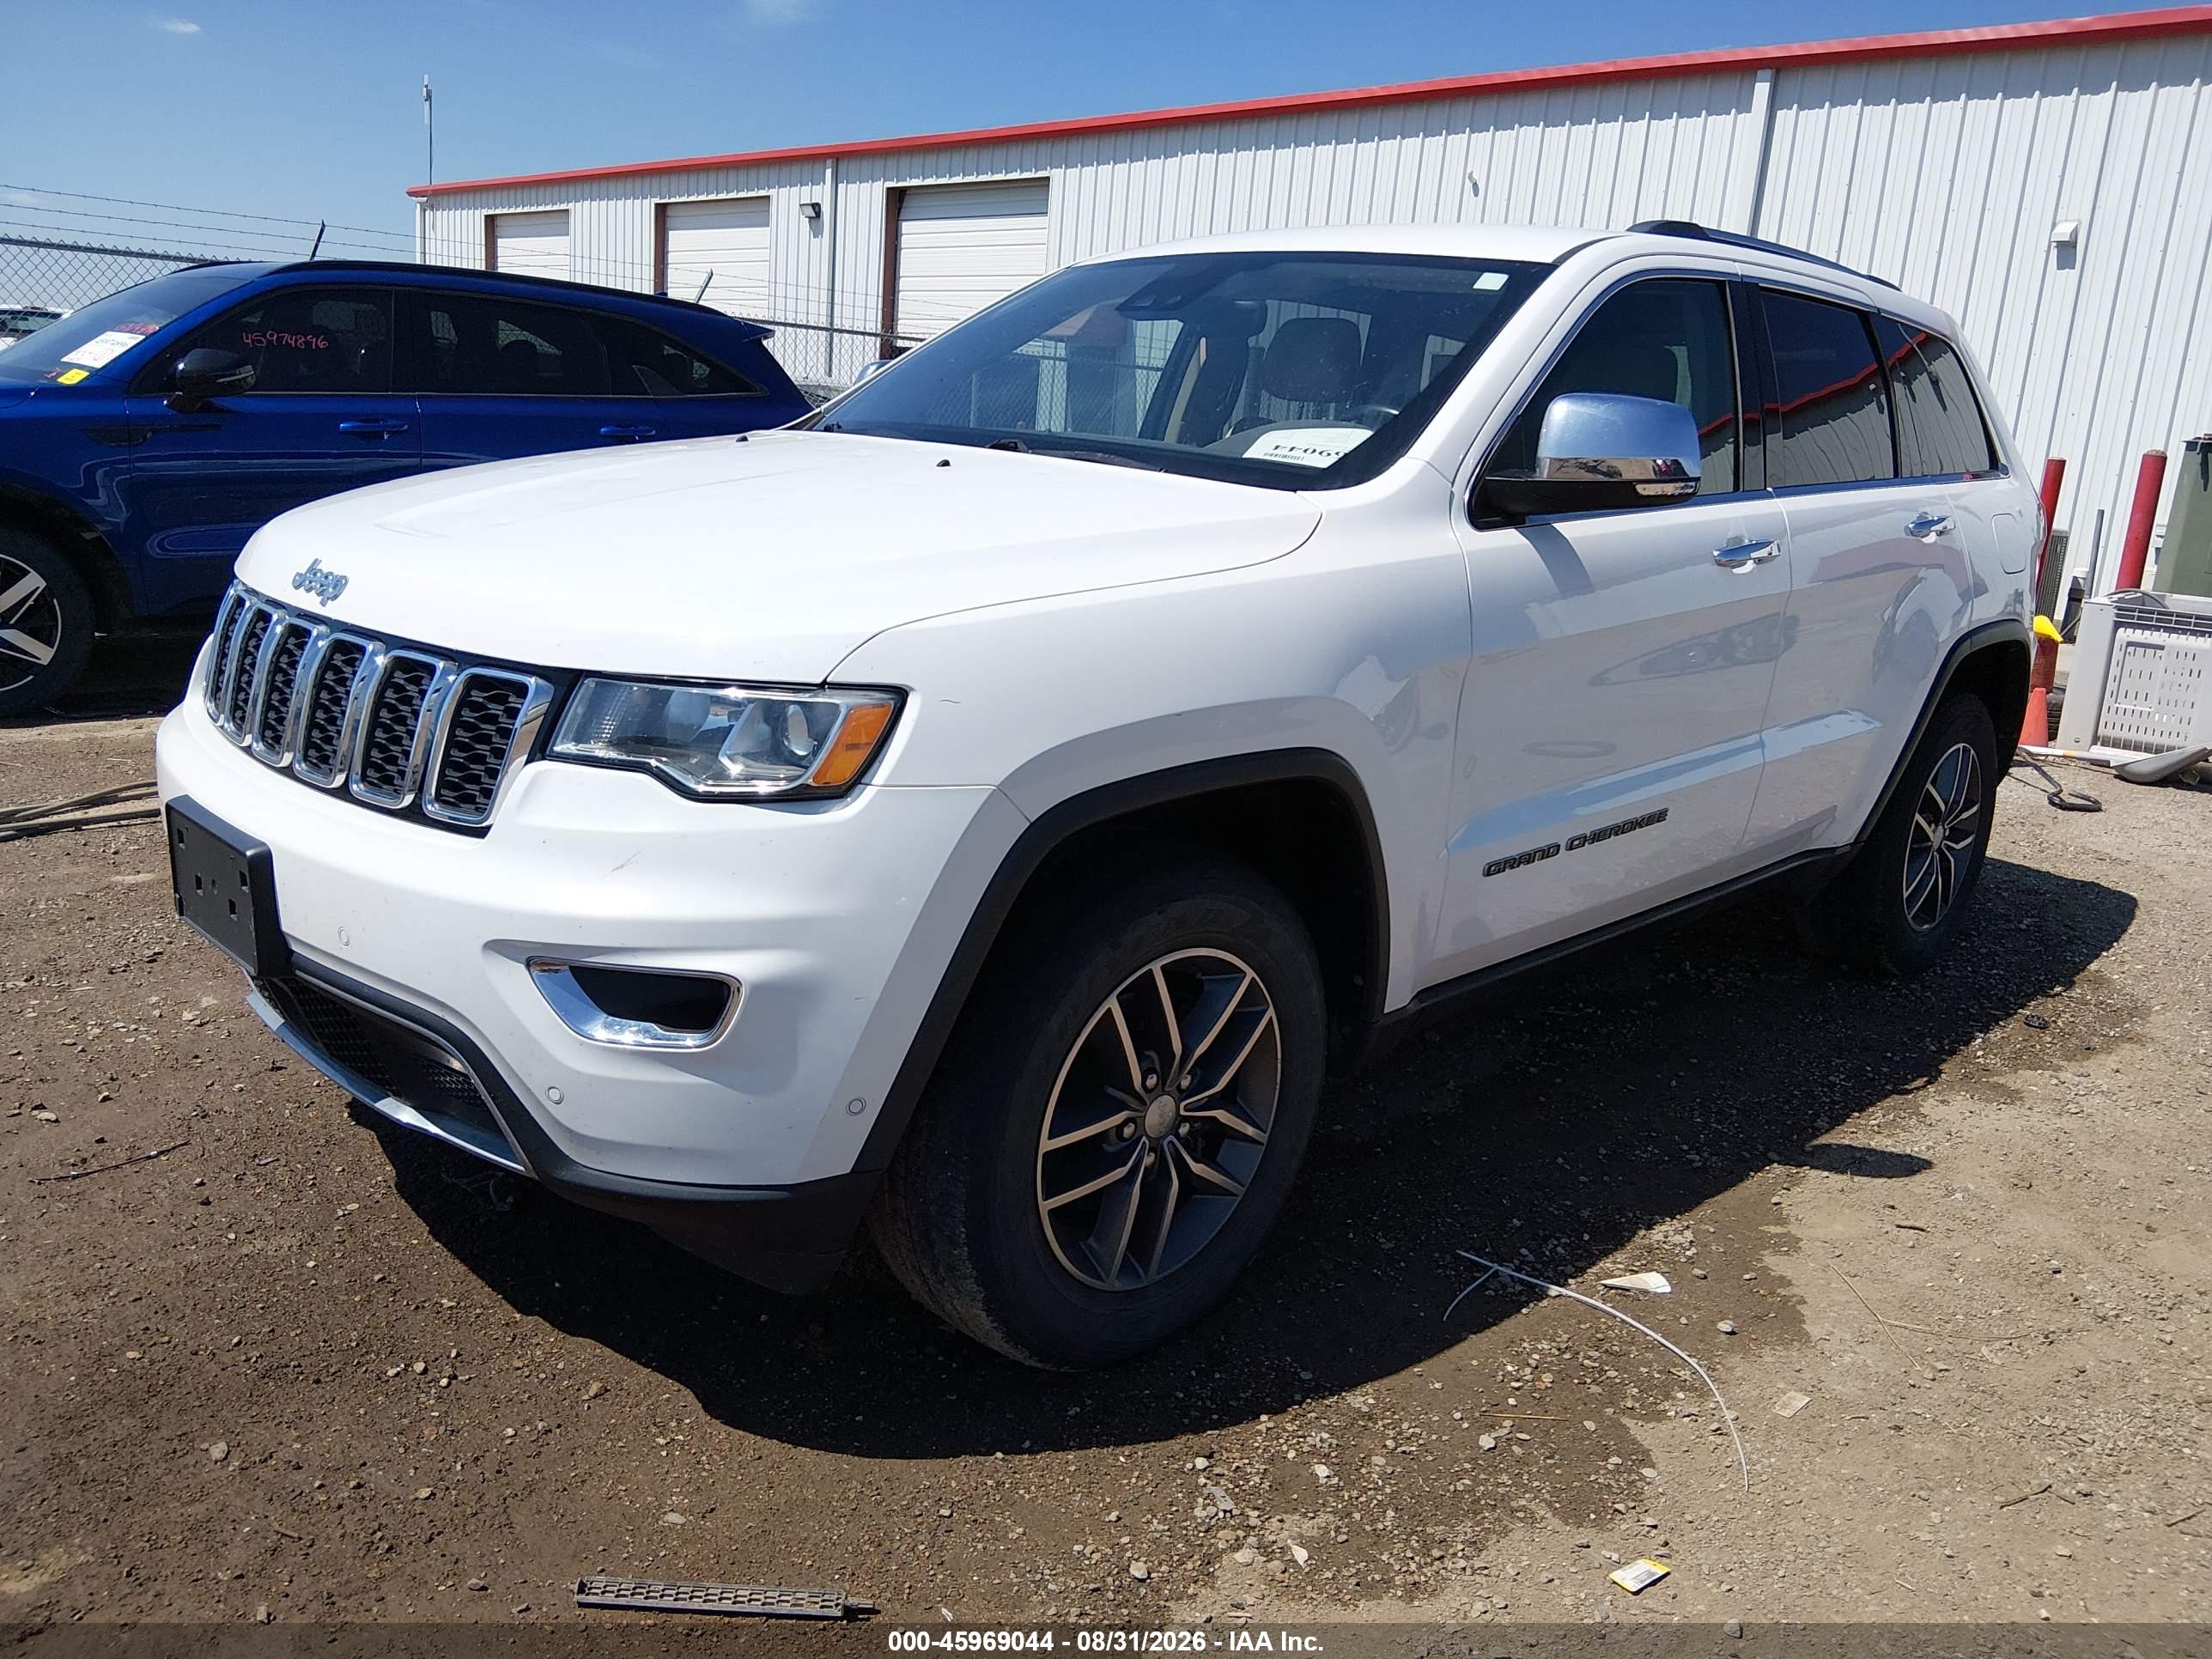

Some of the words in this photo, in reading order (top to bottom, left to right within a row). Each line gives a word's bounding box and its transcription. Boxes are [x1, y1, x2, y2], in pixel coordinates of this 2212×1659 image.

[242, 330, 329, 349] 45974896
[292, 558, 349, 607] Jeep
[1482, 842, 1561, 878] GRAND
[1565, 807, 1670, 852] CHEROKEE
